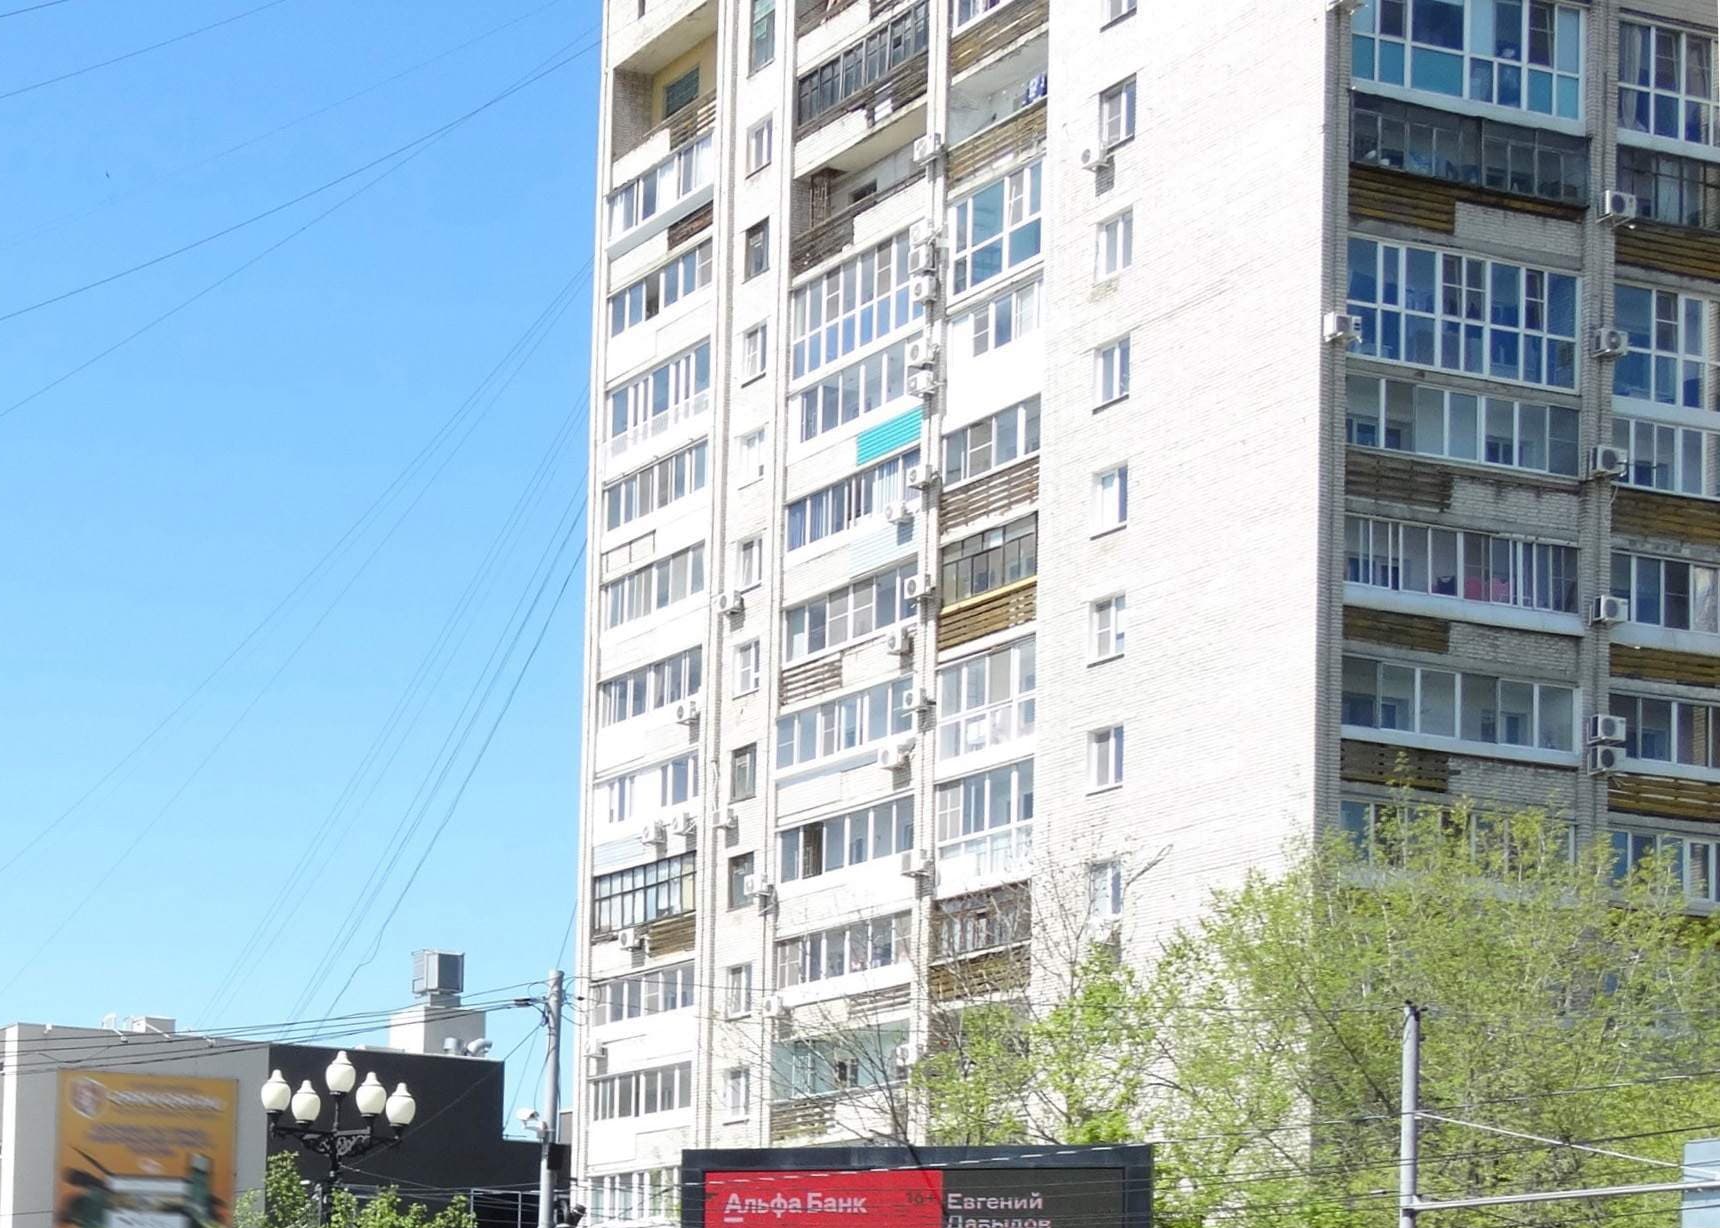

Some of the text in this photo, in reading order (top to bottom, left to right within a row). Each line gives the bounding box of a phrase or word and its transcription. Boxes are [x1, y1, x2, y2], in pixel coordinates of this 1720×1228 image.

[724, 1192, 867, 1219] Альфа Банк
[946, 1191, 1044, 1210] Евгений
